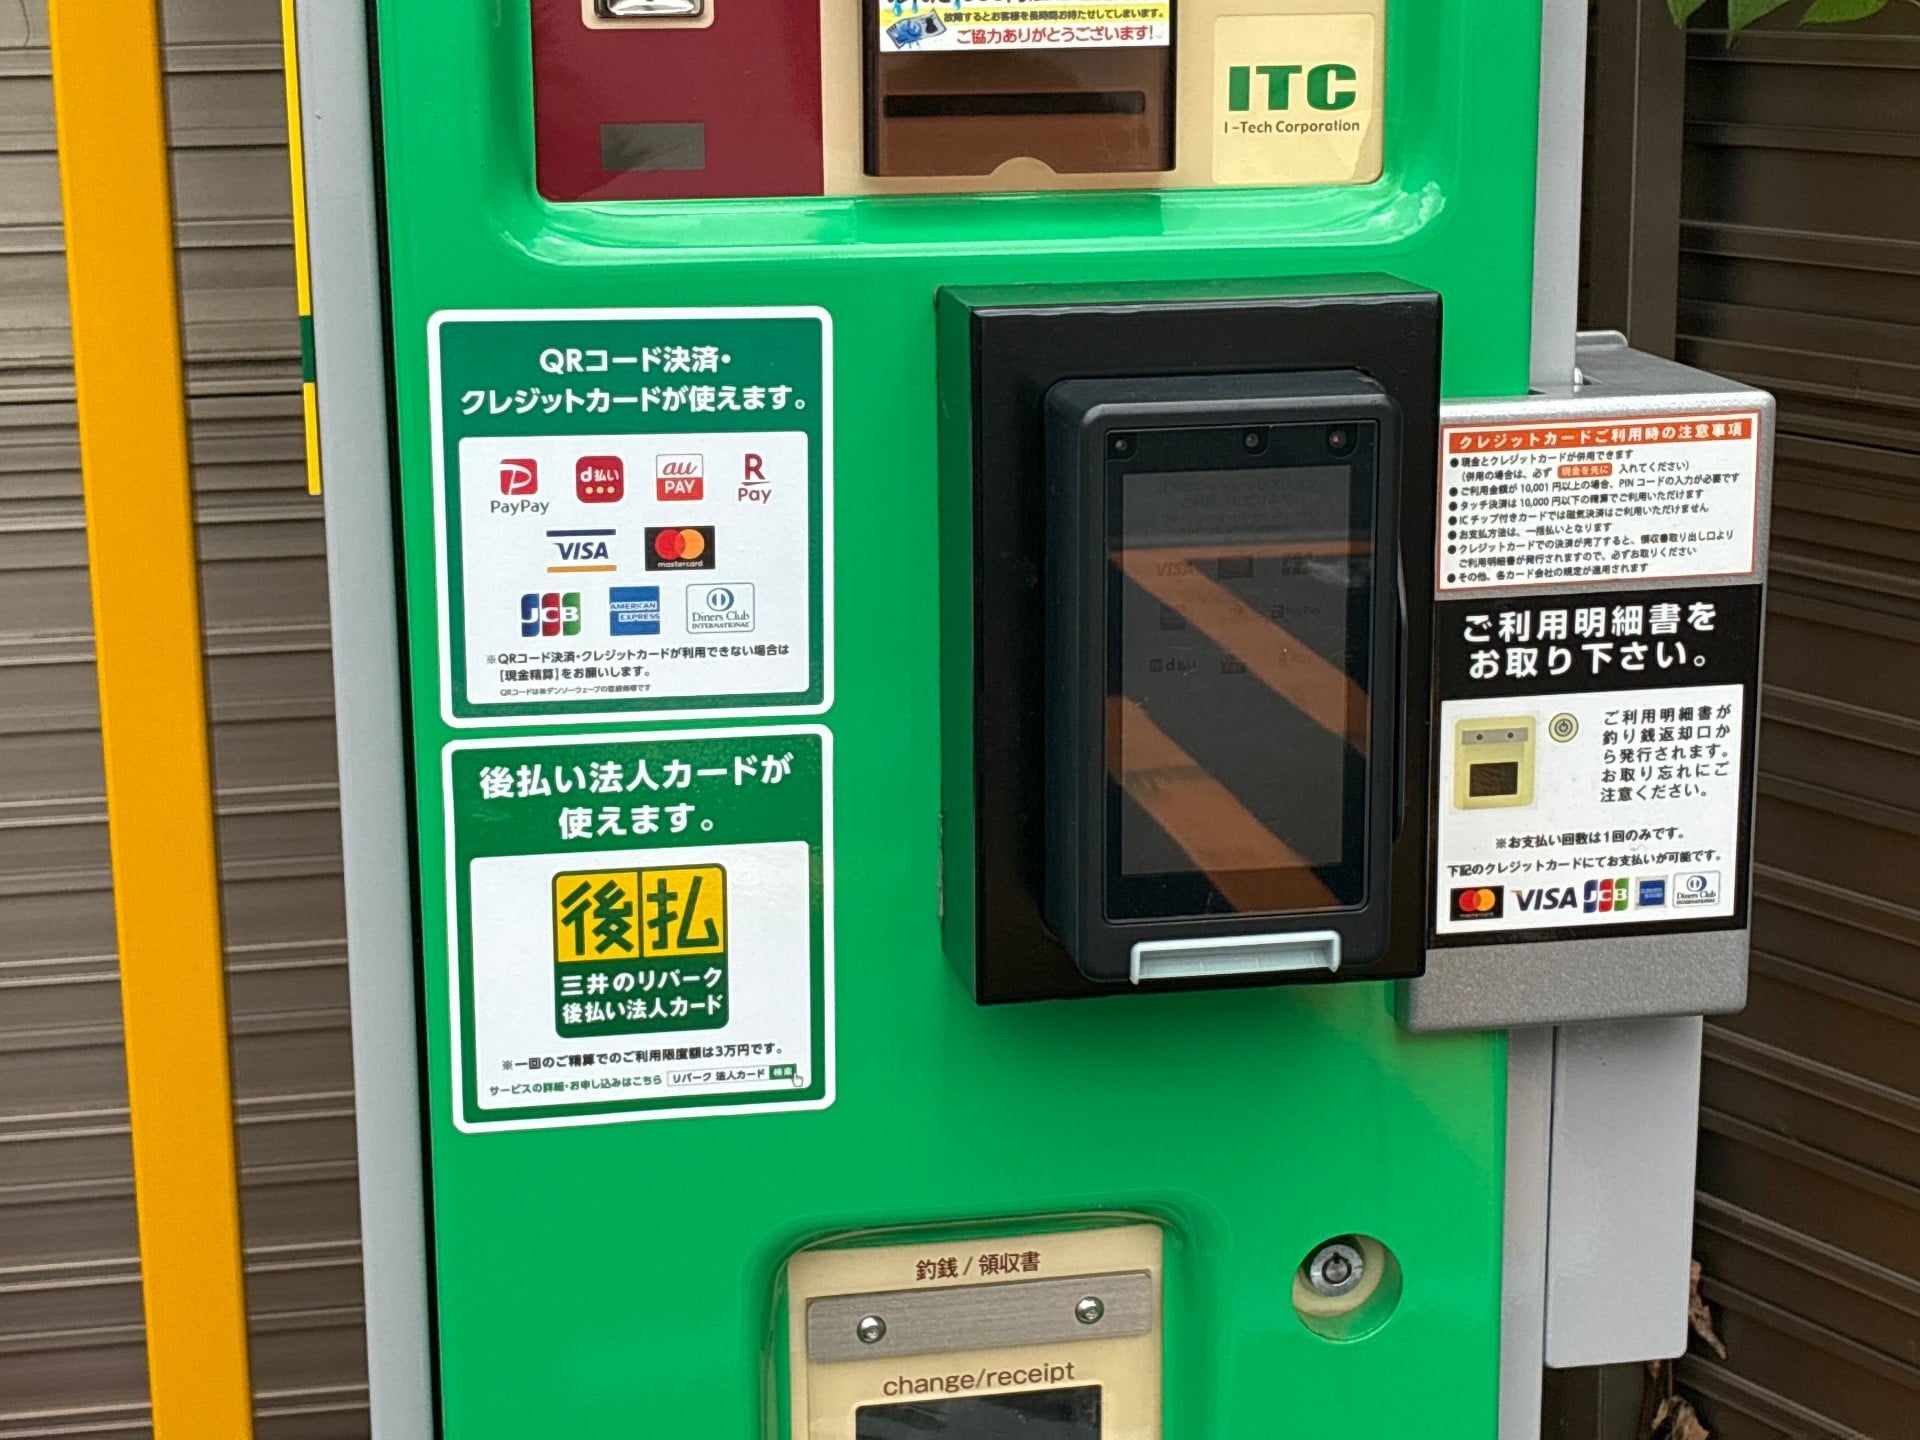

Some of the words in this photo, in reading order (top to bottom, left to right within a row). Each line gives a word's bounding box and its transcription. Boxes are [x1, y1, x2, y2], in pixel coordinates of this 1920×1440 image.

[956, 25, 1154, 45] ご協力ありがとうございます!
[1229, 63, 1356, 111] ITC
[1276, 120, 1360, 134] Corporation
[540, 346, 731, 374] QRコード決済・
[460, 384, 806, 415] クレジットカードが使えます。
[1460, 422, 1742, 450] クレジットカードご利用時の注意事項
[663, 462, 698, 476] au
[1461, 450, 1634, 467] 現金とクレジットカードが併用できます
[581, 467, 620, 482] d払い
[1561, 465, 1609, 476] 現金を先に
[665, 480, 695, 494] PAY
[738, 488, 772, 504] Pay
[491, 500, 550, 516] PayPay
[554, 542, 608, 560] VISA
[658, 560, 703, 568] mastercard
[610, 602, 656, 610] AMERICAN
[620, 613, 660, 621] EXPRESS
[692, 612, 724, 622] Diners
[726, 611, 750, 621] Club
[1463, 602, 1717, 643] ご利用明細書を
[1468, 641, 1706, 680] お取り下さい。
[1603, 704, 1732, 726] ご利用明細書が
[1602, 724, 1731, 746] 釣り銭返却口か
[1602, 743, 1731, 765] ら発行されます。
[480, 751, 794, 800] 後払い法人カードが
[1601, 762, 1731, 783] お取り忘れにご
[1600, 782, 1708, 803] 注意ください。
[558, 802, 713, 840] 使えます。
[1496, 827, 1685, 850] ※お支払い回数は1回のみです。
[1447, 850, 1722, 877] 下記のクレジットカードにてお支払いが可能です。
[1512, 887, 1577, 911] VISA
[561, 875, 720, 956] 後払
[561, 966, 722, 997] 三井のリパーク
[562, 994, 724, 1025] 後払い法人カード
[672, 1071, 711, 1084] リパーク
[715, 1069, 766, 1082] 法人カード
[915, 1257, 958, 1282] 釣銭
[979, 1250, 1041, 1275] 領収書
[883, 1362, 1075, 1397] change/receipt
